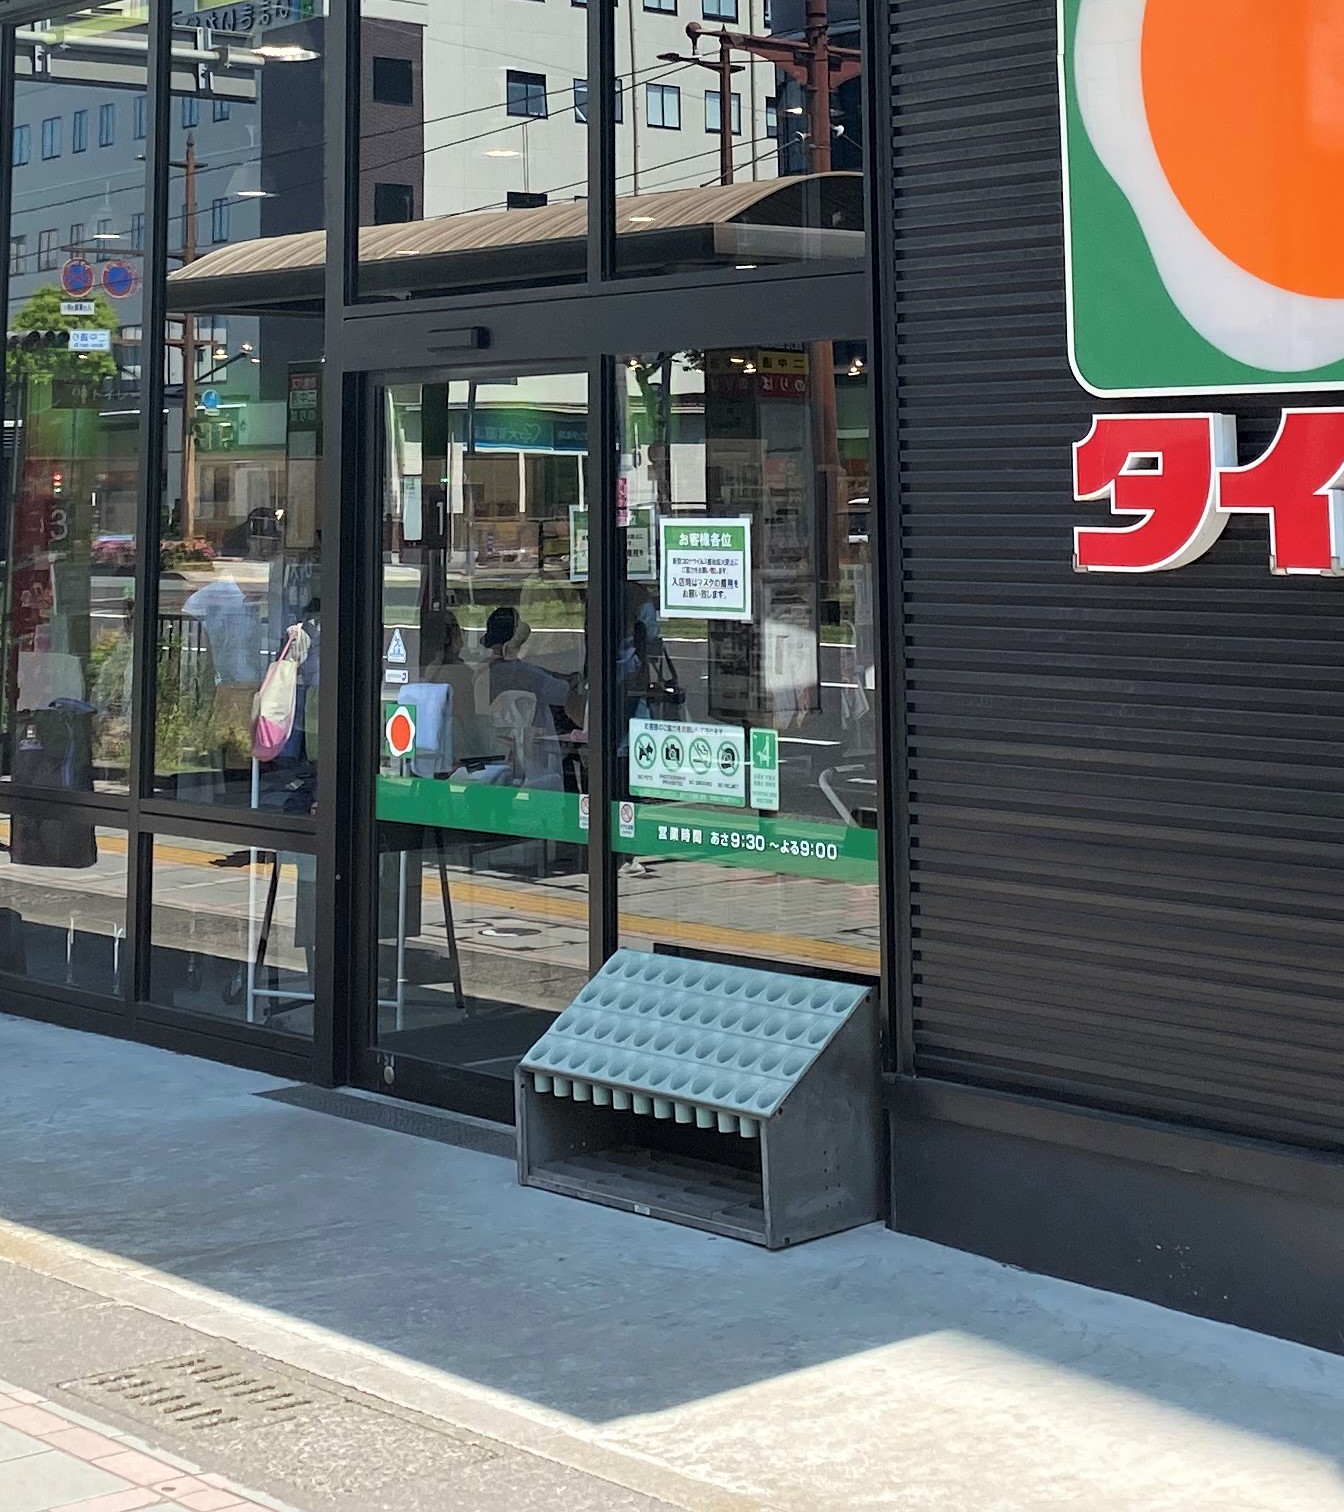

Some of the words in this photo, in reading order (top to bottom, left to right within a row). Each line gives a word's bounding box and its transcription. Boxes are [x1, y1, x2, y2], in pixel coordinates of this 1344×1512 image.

[678, 531, 733, 548] お客様各位
[658, 825, 703, 845] 営業時間
